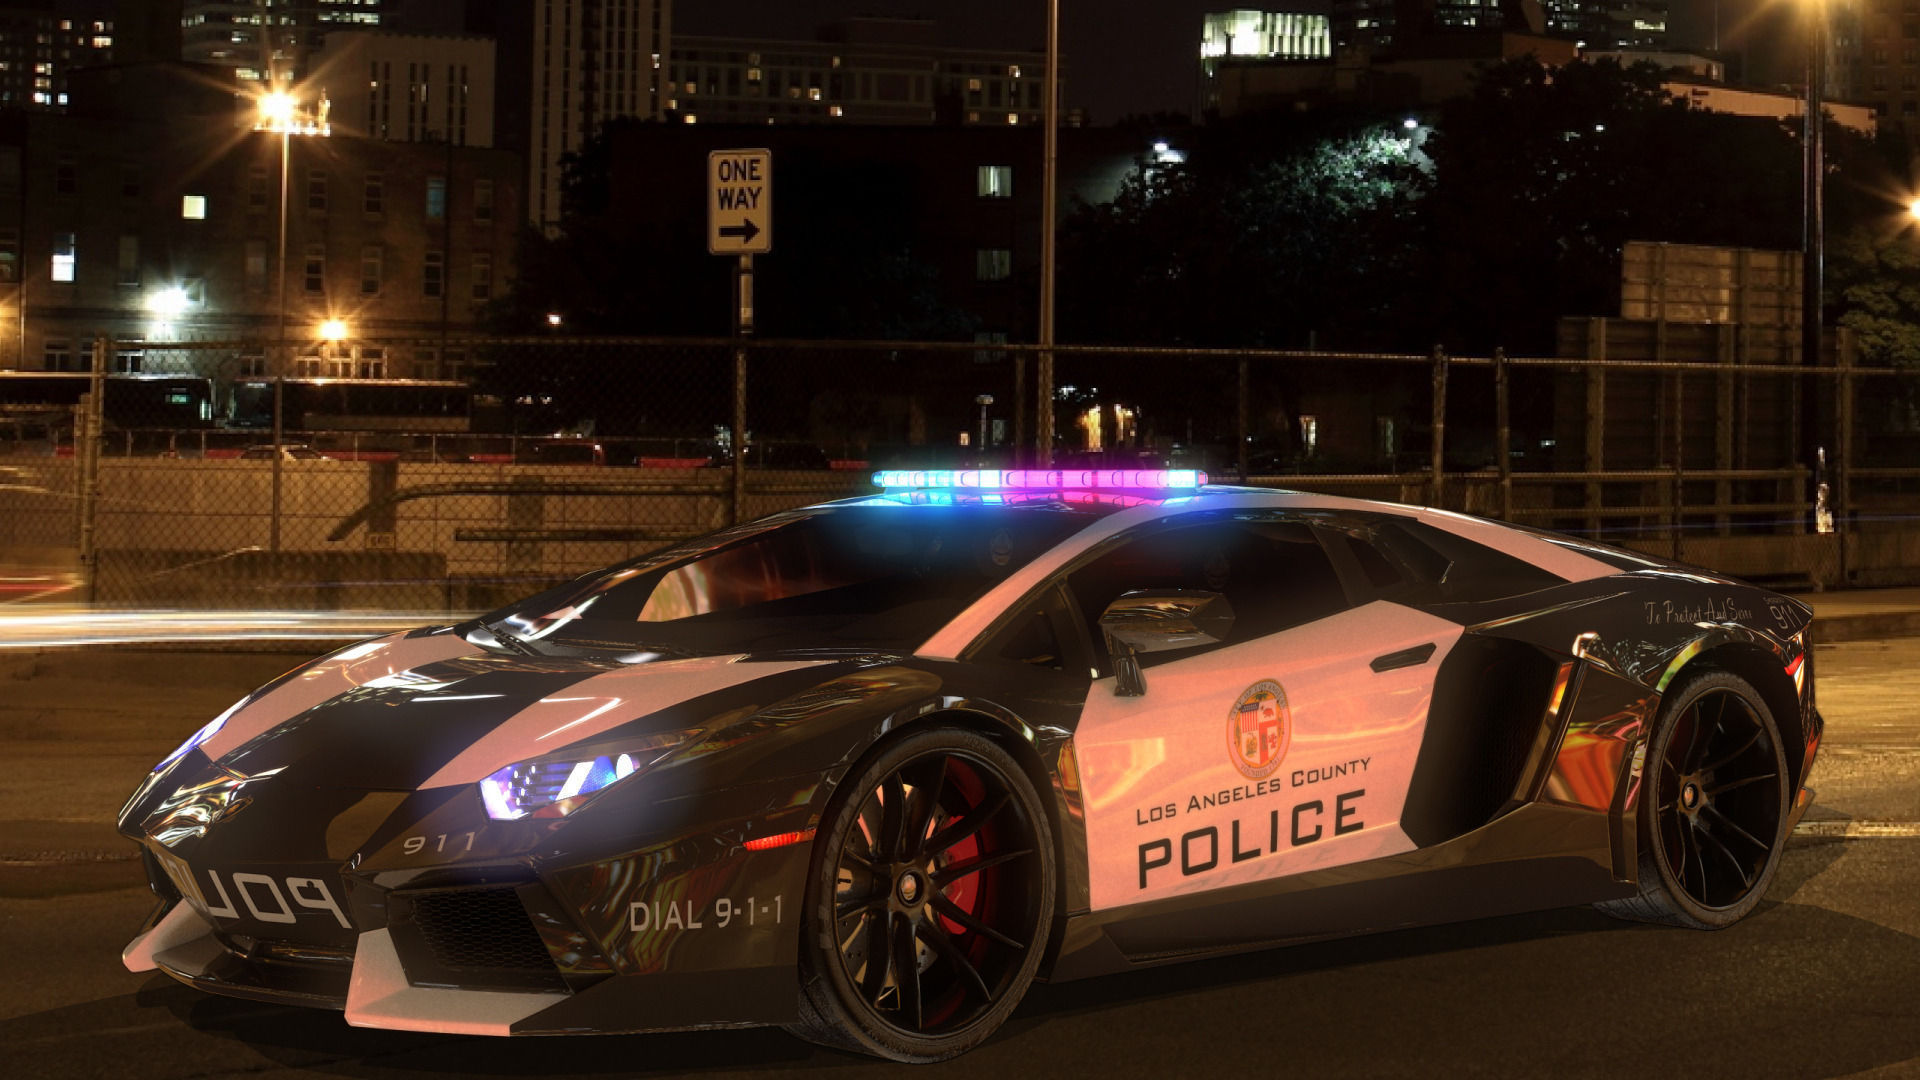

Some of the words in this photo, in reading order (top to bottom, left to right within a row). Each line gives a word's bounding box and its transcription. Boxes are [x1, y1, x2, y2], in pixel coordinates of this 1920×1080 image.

[718, 159, 762, 182] ONE
[718, 186, 762, 210] WAY
[1643, 600, 1661, 625] To
[1663, 599, 1703, 625] Protect
[1704, 597, 1728, 622] And
[1770, 604, 1803, 630] 911
[403, 831, 476, 855] 911
[1139, 789, 1365, 890] POLICE
[630, 900, 702, 932] DIAL
[715, 894, 782, 929] 9-1-1
